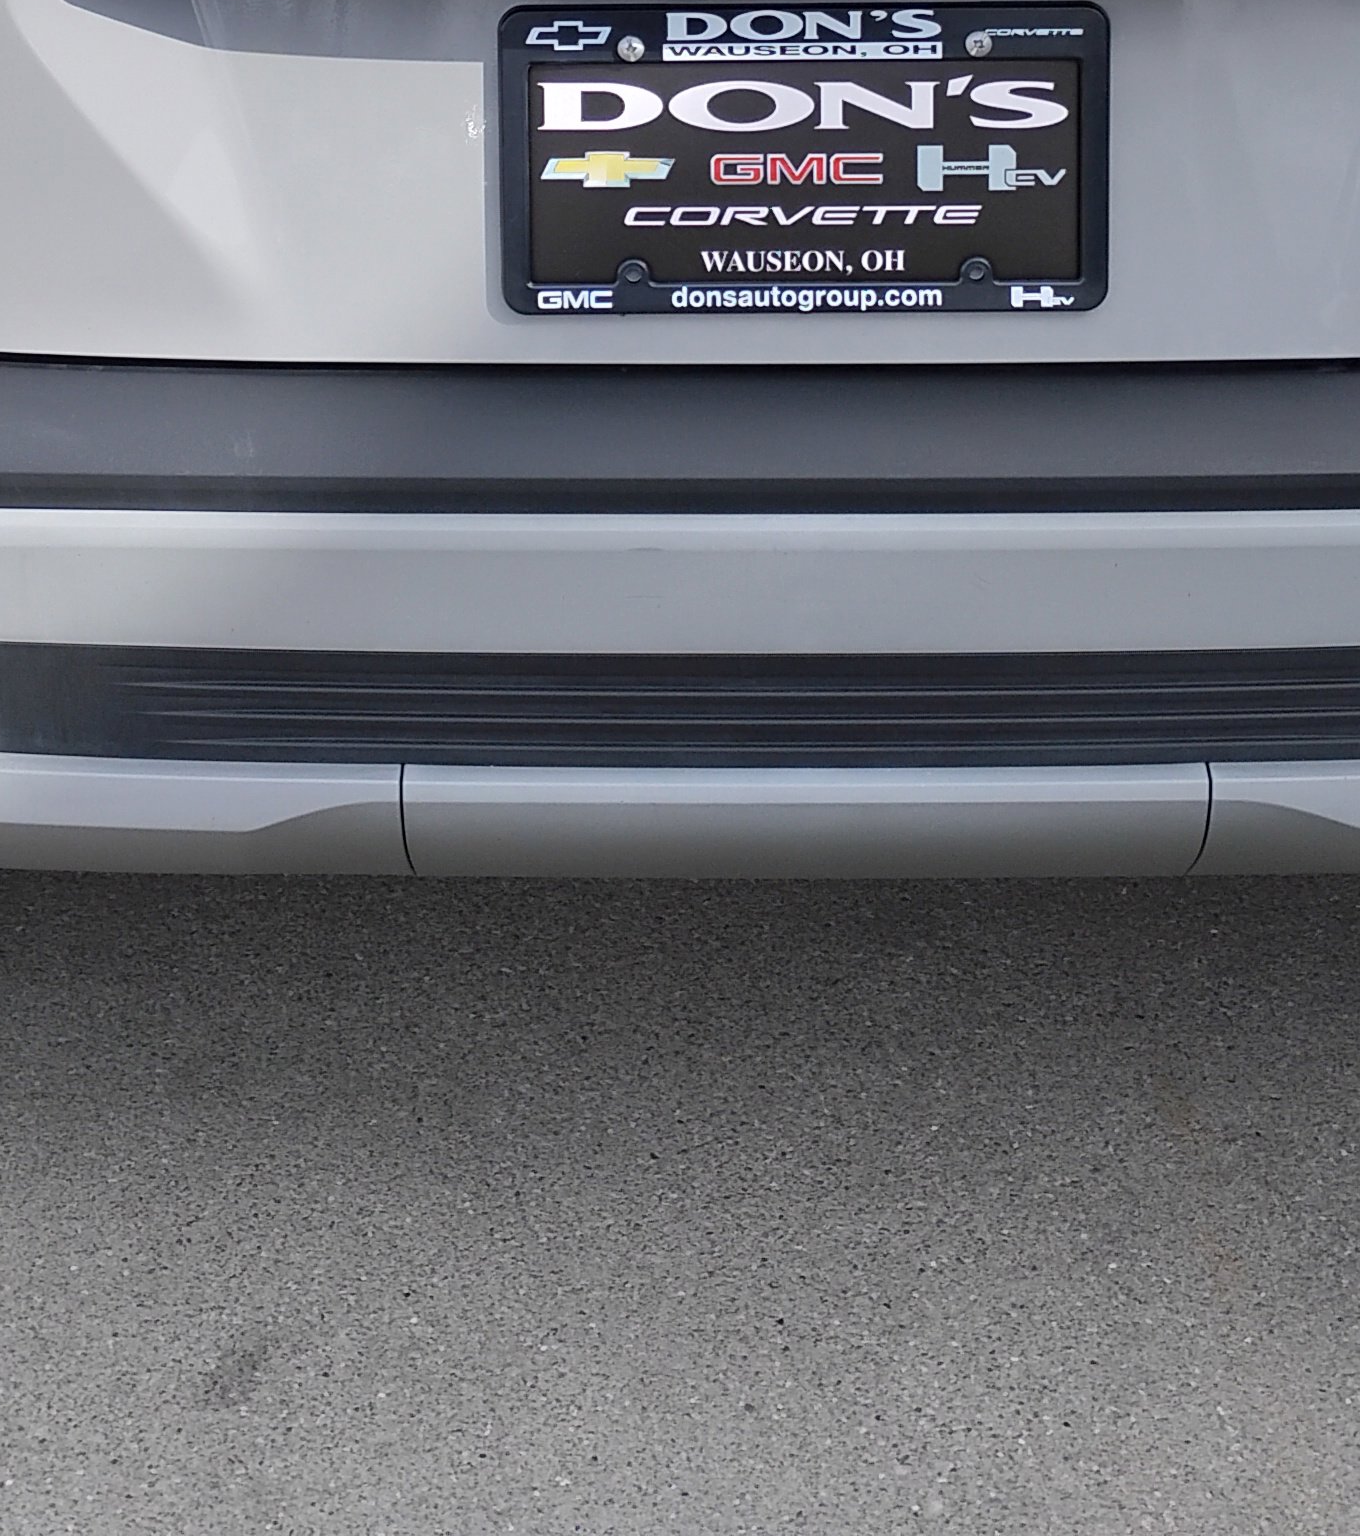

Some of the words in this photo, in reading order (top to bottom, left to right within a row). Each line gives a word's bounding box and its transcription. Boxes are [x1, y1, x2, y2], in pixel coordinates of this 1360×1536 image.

[666, 9, 942, 40] DON'S
[985, 28, 1084, 36] CORVETTE
[668, 44, 867, 57] WAUSEON,
[883, 44, 937, 56] OH
[538, 74, 1069, 132] DON'S
[710, 153, 884, 186] GMC
[623, 205, 983, 226] CORVETTE
[701, 249, 853, 275] WAUSEON,
[861, 249, 905, 271] OH
[537, 290, 613, 309] GMC
[671, 285, 942, 312] donsautogroup.com
